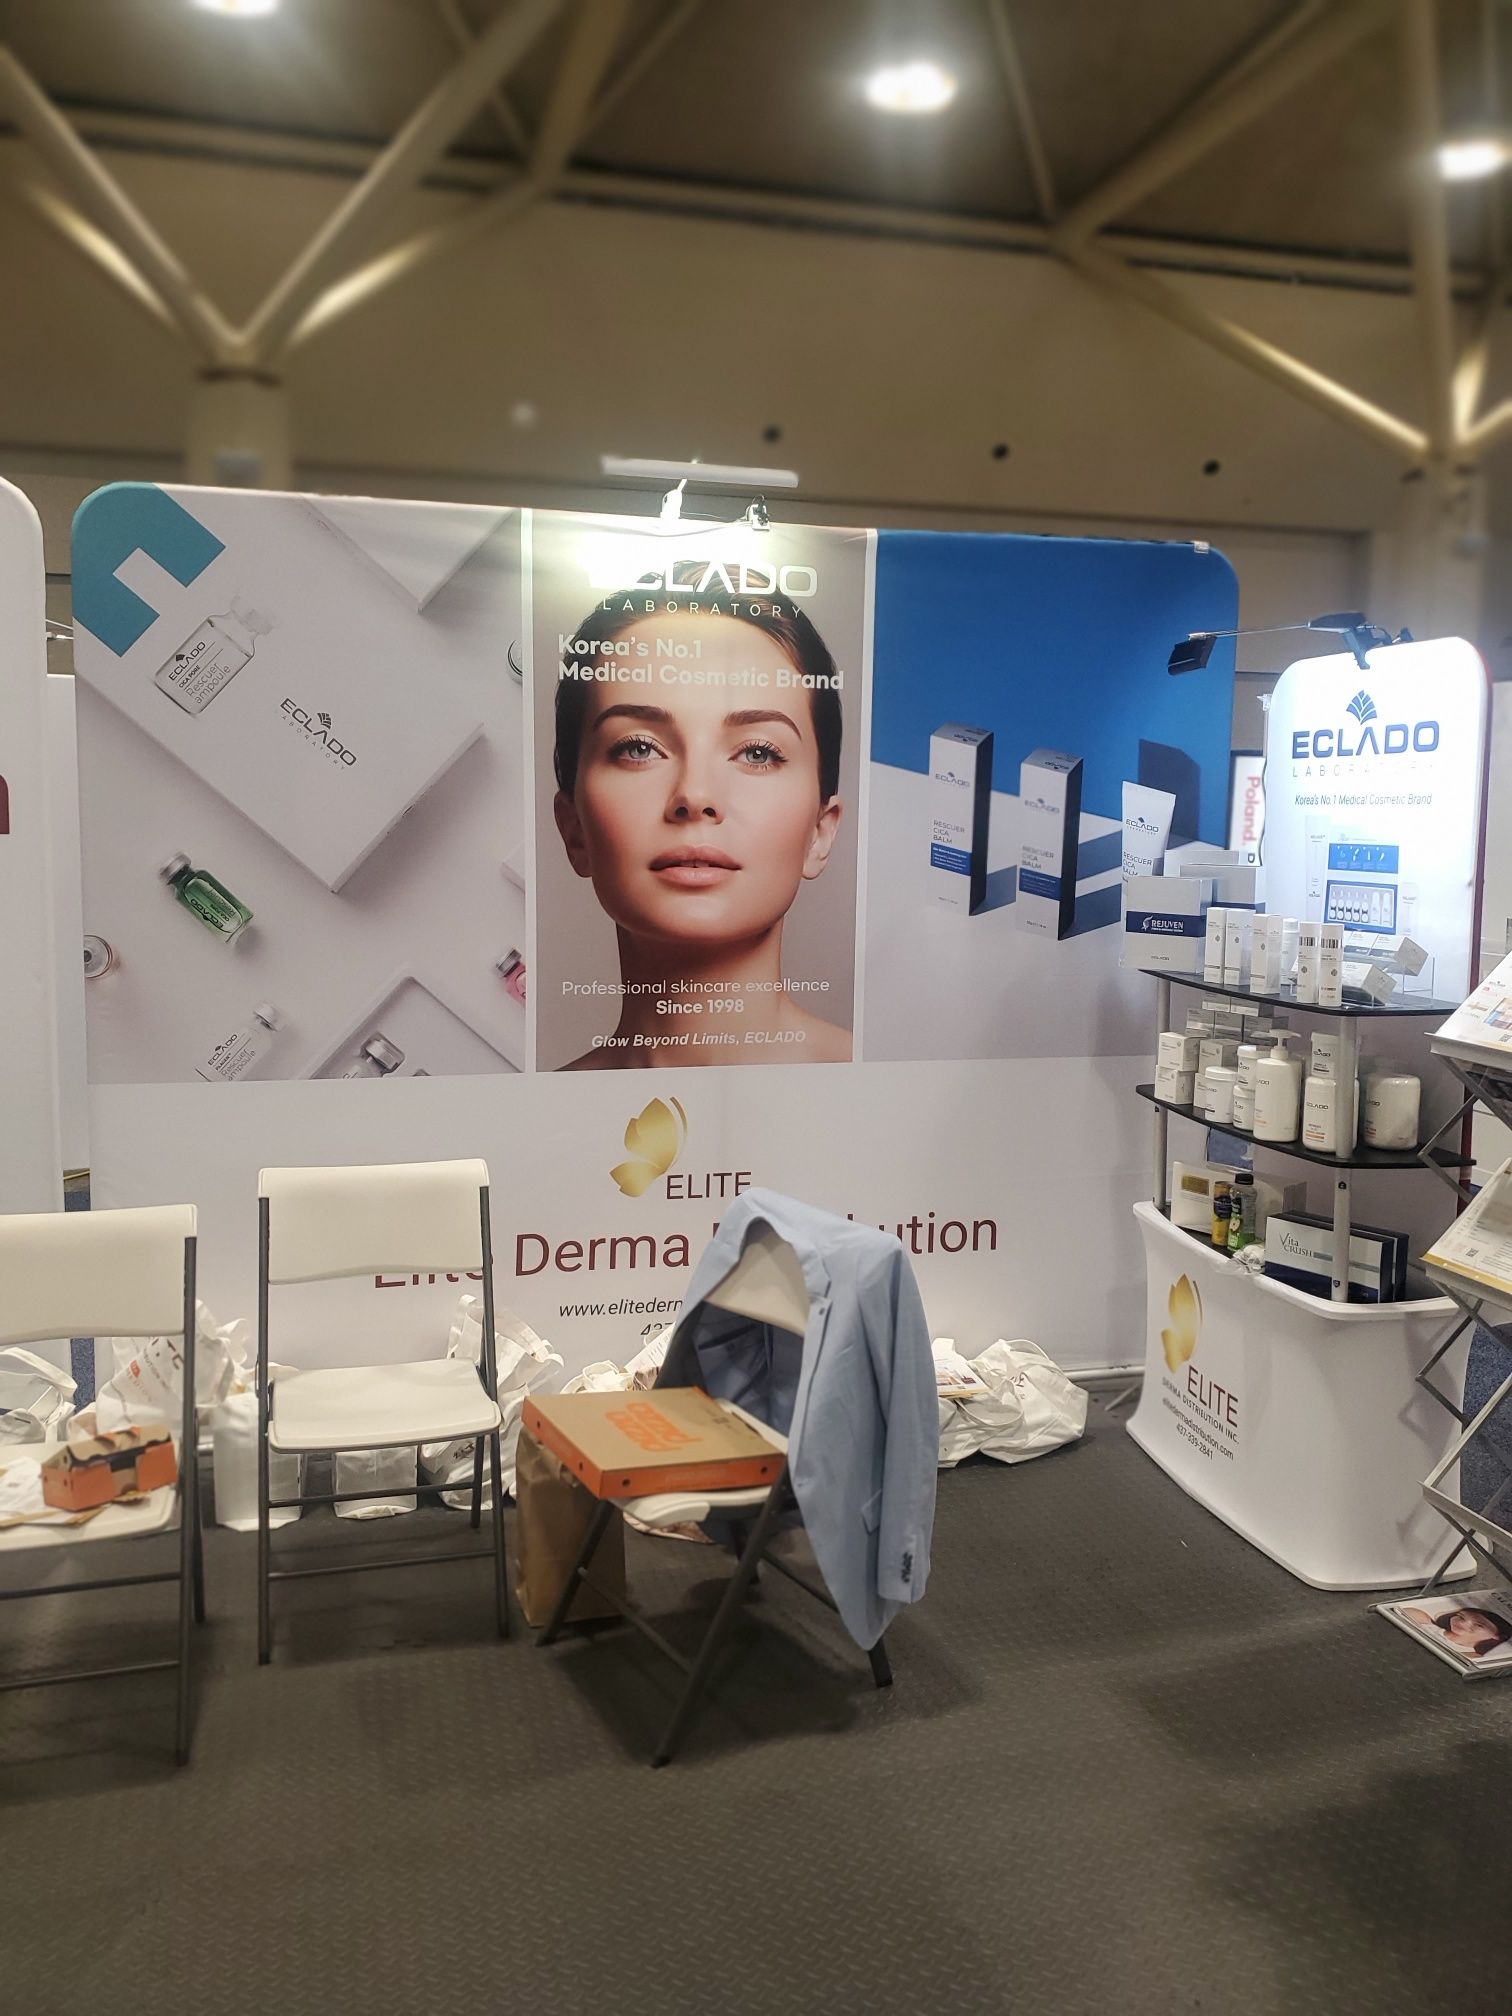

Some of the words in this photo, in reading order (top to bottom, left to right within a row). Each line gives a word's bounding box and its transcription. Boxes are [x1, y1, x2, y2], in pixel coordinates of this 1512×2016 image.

[602, 599, 802, 618] LABORATORY
[558, 634, 649, 658] Korea's
[656, 638, 702, 659] No.1
[558, 661, 652, 684] Medical
[659, 665, 770, 689] Cosmetic
[775, 668, 845, 690] Brand
[280, 697, 357, 766] ECLADO
[1292, 720, 1440, 760] ECLADO
[1294, 794, 1319, 806] Korea's
[1338, 794, 1368, 806] Medical
[1369, 793, 1406, 805] Cosmetic
[1407, 792, 1433, 805] Brand
[1151, 919, 1184, 930] REJUVEN
[561, 979, 667, 996] Professional
[670, 979, 741, 994] skincare
[745, 977, 831, 993] excellence
[656, 998, 703, 1015] Since
[707, 998, 745, 1014] 1998
[591, 1034, 630, 1048] Glow
[632, 1032, 689, 1050] Beyond
[692, 1031, 740, 1047] Limits,
[744, 1030, 807, 1045] ECLADO
[665, 1171, 753, 1200] ELITE
[1279, 1232, 1299, 1248] Vita
[514, 1231, 691, 1277] Derma
[1187, 1365, 1239, 1428] ELITE
